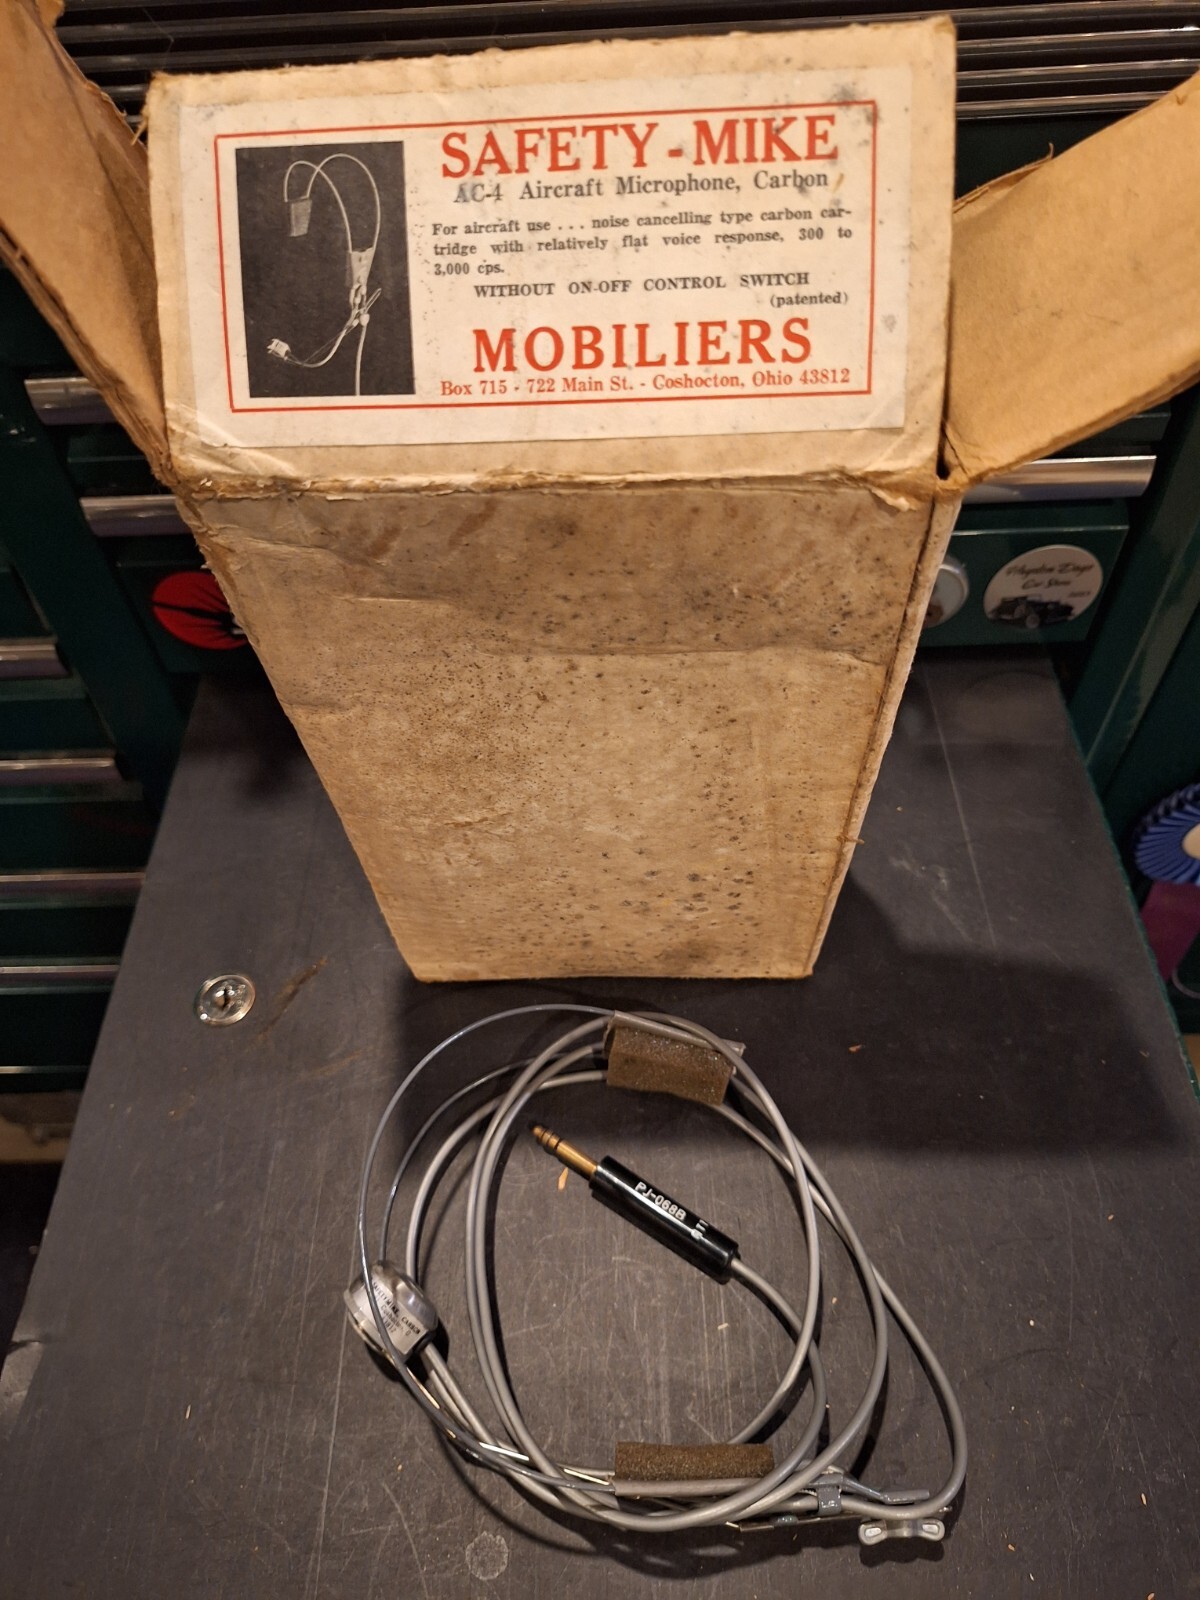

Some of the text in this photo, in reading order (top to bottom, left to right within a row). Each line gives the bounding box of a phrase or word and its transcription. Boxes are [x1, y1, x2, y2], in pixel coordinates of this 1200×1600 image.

[441, 123, 659, 178] SAFETY
[693, 114, 839, 166] MIKE
[453, 169, 829, 203] AC-4 Aircraft Microphone, Carbon
[432, 223, 457, 236] For
[464, 219, 520, 234] aircraft
[527, 220, 551, 231] use
[592, 215, 629, 229] noise
[636, 211, 713, 227] cancelling
[719, 211, 753, 224] type
[760, 207, 812, 222] carbon
[820, 208, 852, 219] car-
[433, 227, 853, 256] tridge with relatively flat voice response, 300 to
[434, 262, 505, 276] 3,000 cps.
[474, 272, 810, 298] WITHOUT ON-OFF CONTROL SWITCH
[770, 292, 849, 308] (patented)
[473, 317, 811, 373] MOBILIERS
[441, 381, 472, 396] Box
[480, 380, 507, 395] 715
[527, 378, 555, 394] 722
[562, 376, 604, 392] Main
[610, 375, 634, 391] St.
[653, 373, 745, 390] Coshocton,
[752, 370, 793, 387] Ohio
[799, 368, 850, 385] 43812
[635, 1181, 686, 1221] PJ-068B
